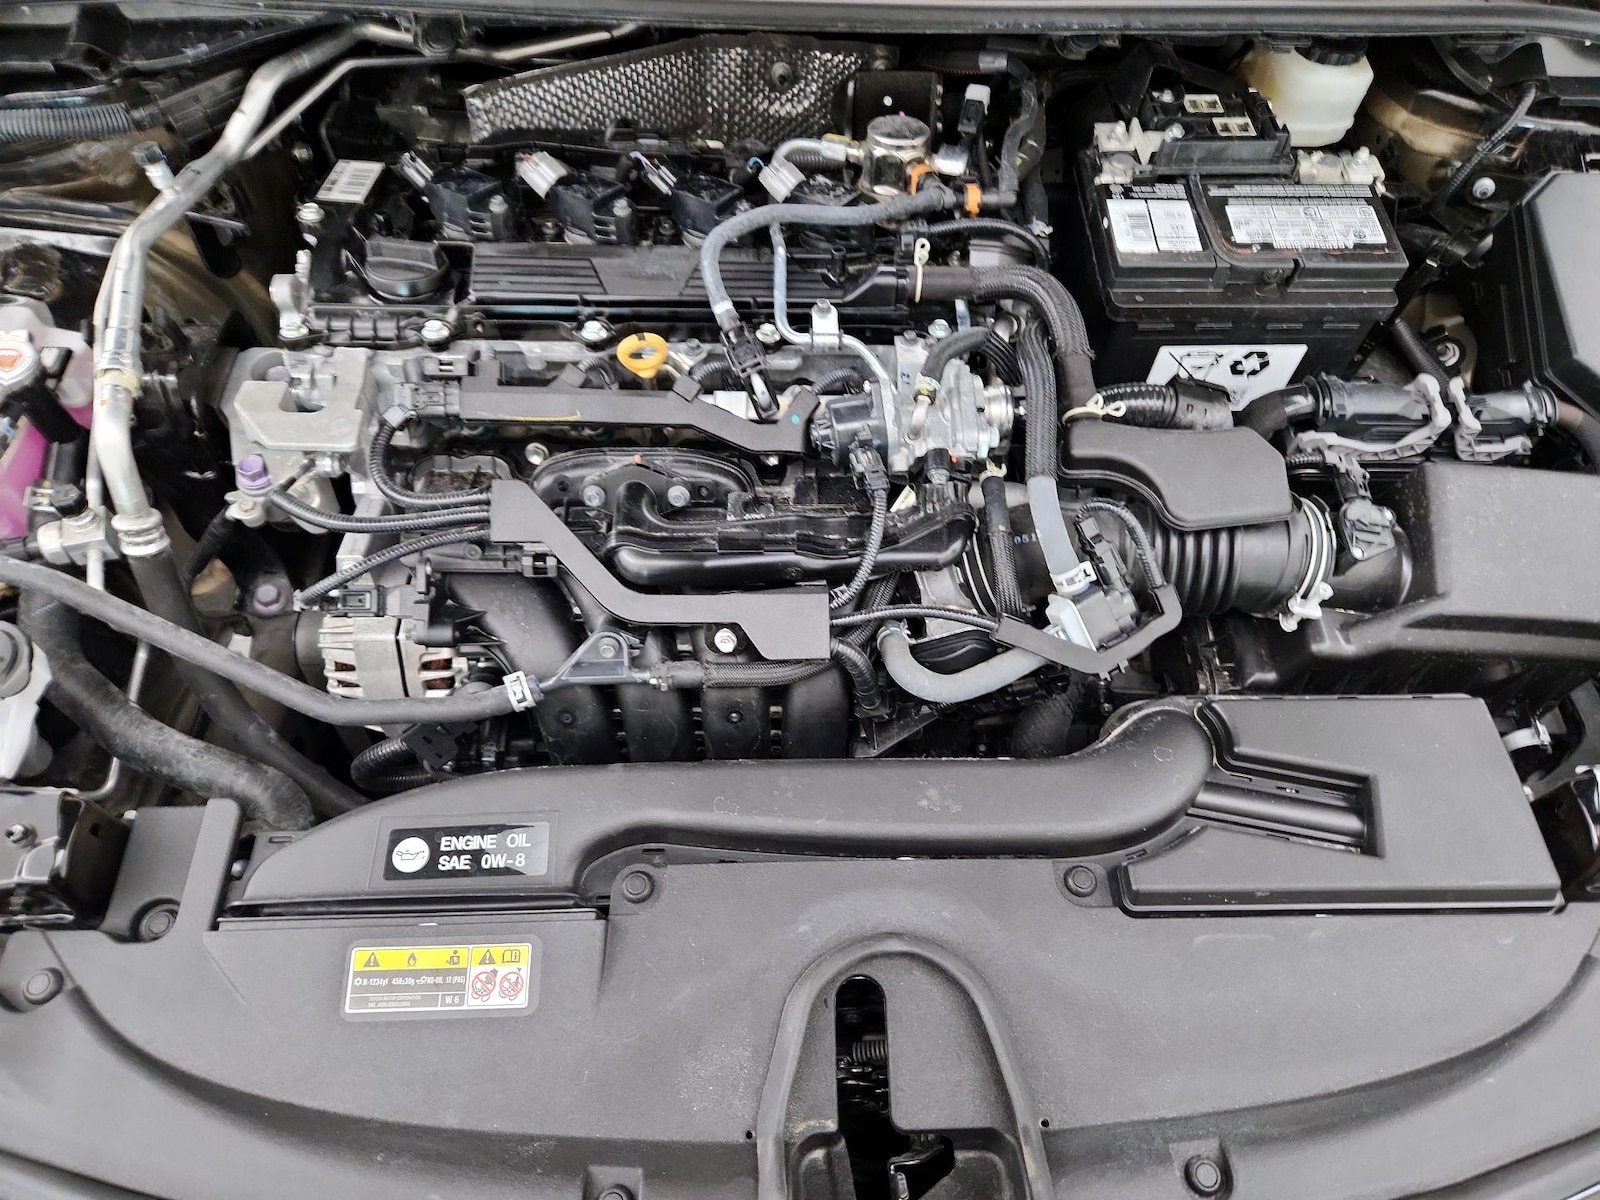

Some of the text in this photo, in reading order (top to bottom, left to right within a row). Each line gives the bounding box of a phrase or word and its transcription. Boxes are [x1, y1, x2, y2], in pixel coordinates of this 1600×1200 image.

[440, 833, 532, 851] ENGINE OIL
[438, 853, 526, 871] SAE 0W-8
[445, 995, 460, 1004] W 6
